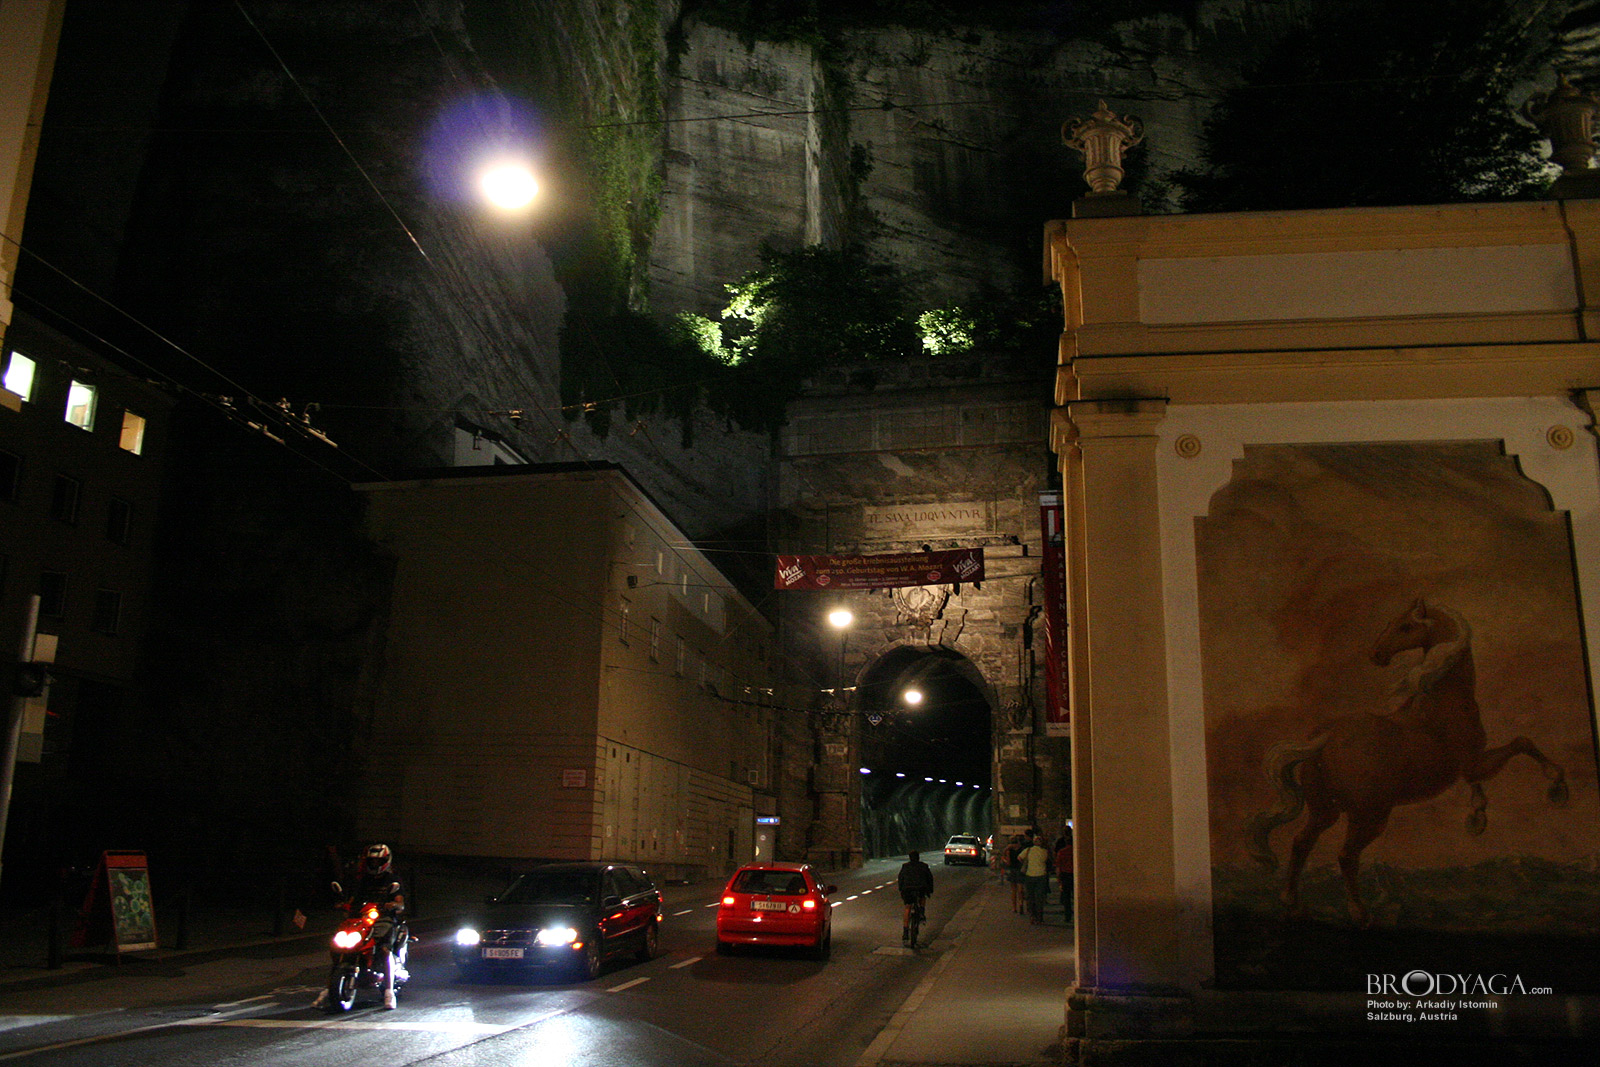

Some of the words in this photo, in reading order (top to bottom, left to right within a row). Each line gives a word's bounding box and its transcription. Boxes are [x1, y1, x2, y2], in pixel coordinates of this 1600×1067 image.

[846, 566, 886, 575] Geburtstag
[918, 563, 943, 571] Mozart
[960, 564, 981, 579] MOZART
[785, 571, 806, 586] MOZART
